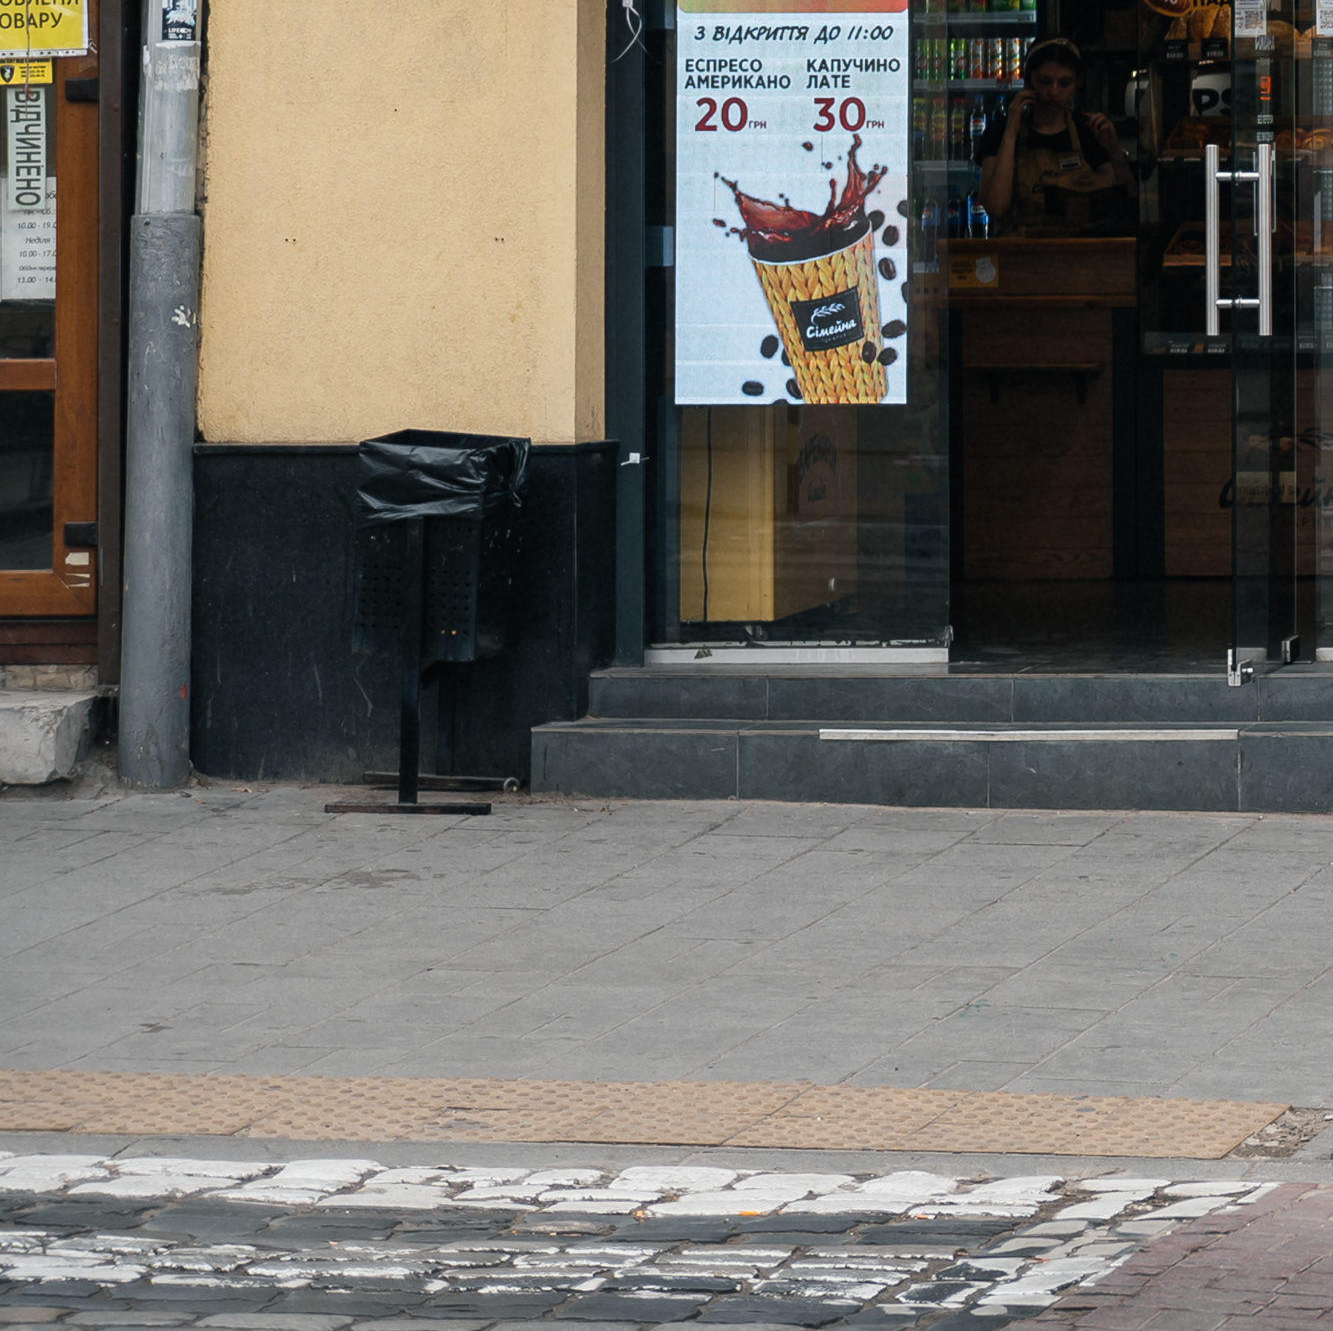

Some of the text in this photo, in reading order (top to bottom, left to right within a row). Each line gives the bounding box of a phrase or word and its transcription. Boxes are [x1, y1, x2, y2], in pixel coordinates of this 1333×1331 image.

[712, 25, 809, 44] ВІДКРИТТЯ
[814, 25, 841, 45] ДО
[847, 25, 894, 41] 11:00
[685, 58, 763, 73] ЕСПРЕСО
[806, 58, 901, 73] КАПУЧИНО
[684, 75, 791, 89] АМЕРИКАНО
[806, 75, 851, 89] ЛАТЕ
[695, 97, 767, 132] 20 ГРН
[813, 97, 885, 132] 30 ГРН
[10, 90, 42, 206] ВІДЧИНЕНО
[806, 319, 857, 338] Сімейна
